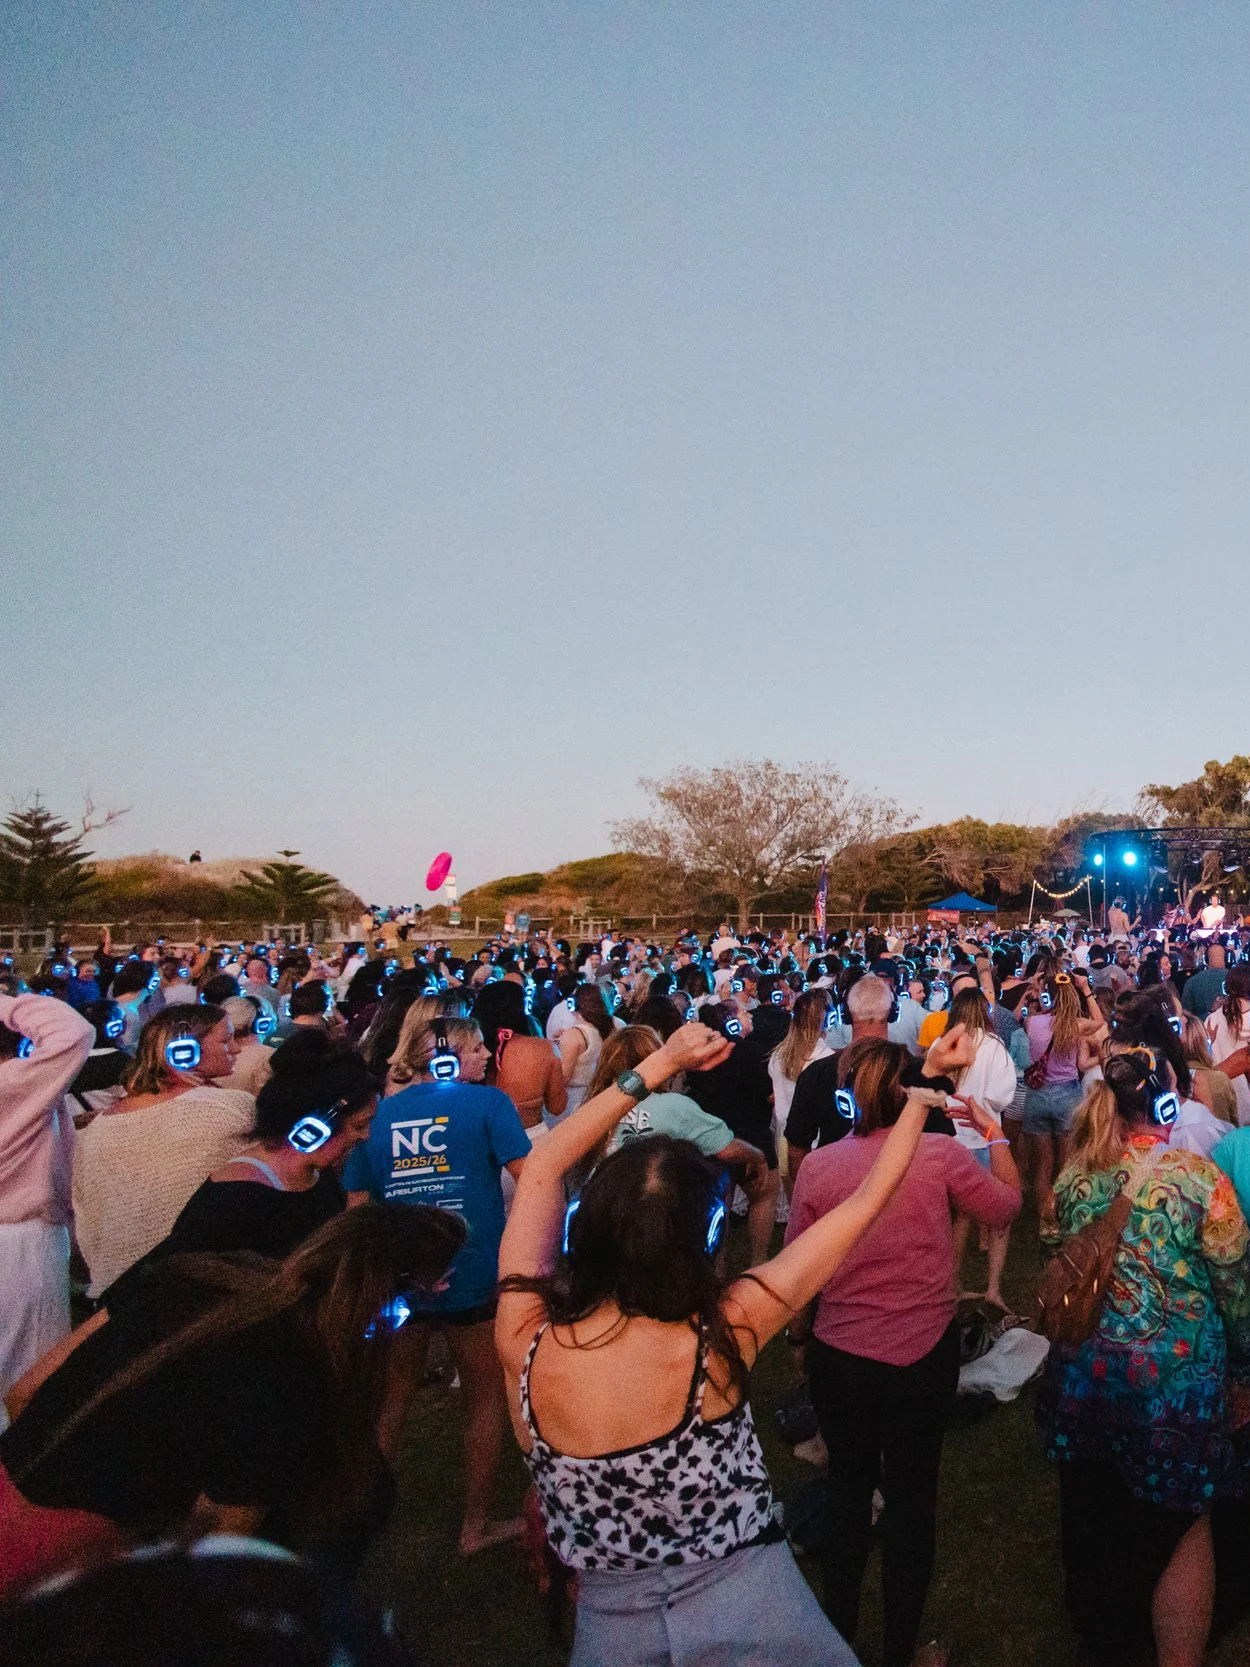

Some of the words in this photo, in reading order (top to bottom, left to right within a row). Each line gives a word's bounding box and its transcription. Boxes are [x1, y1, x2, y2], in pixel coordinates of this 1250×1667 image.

[392, 1124, 448, 1157] NC
[393, 1154, 447, 1170] 2025/26
[384, 1184, 445, 1199] ARBURTON
